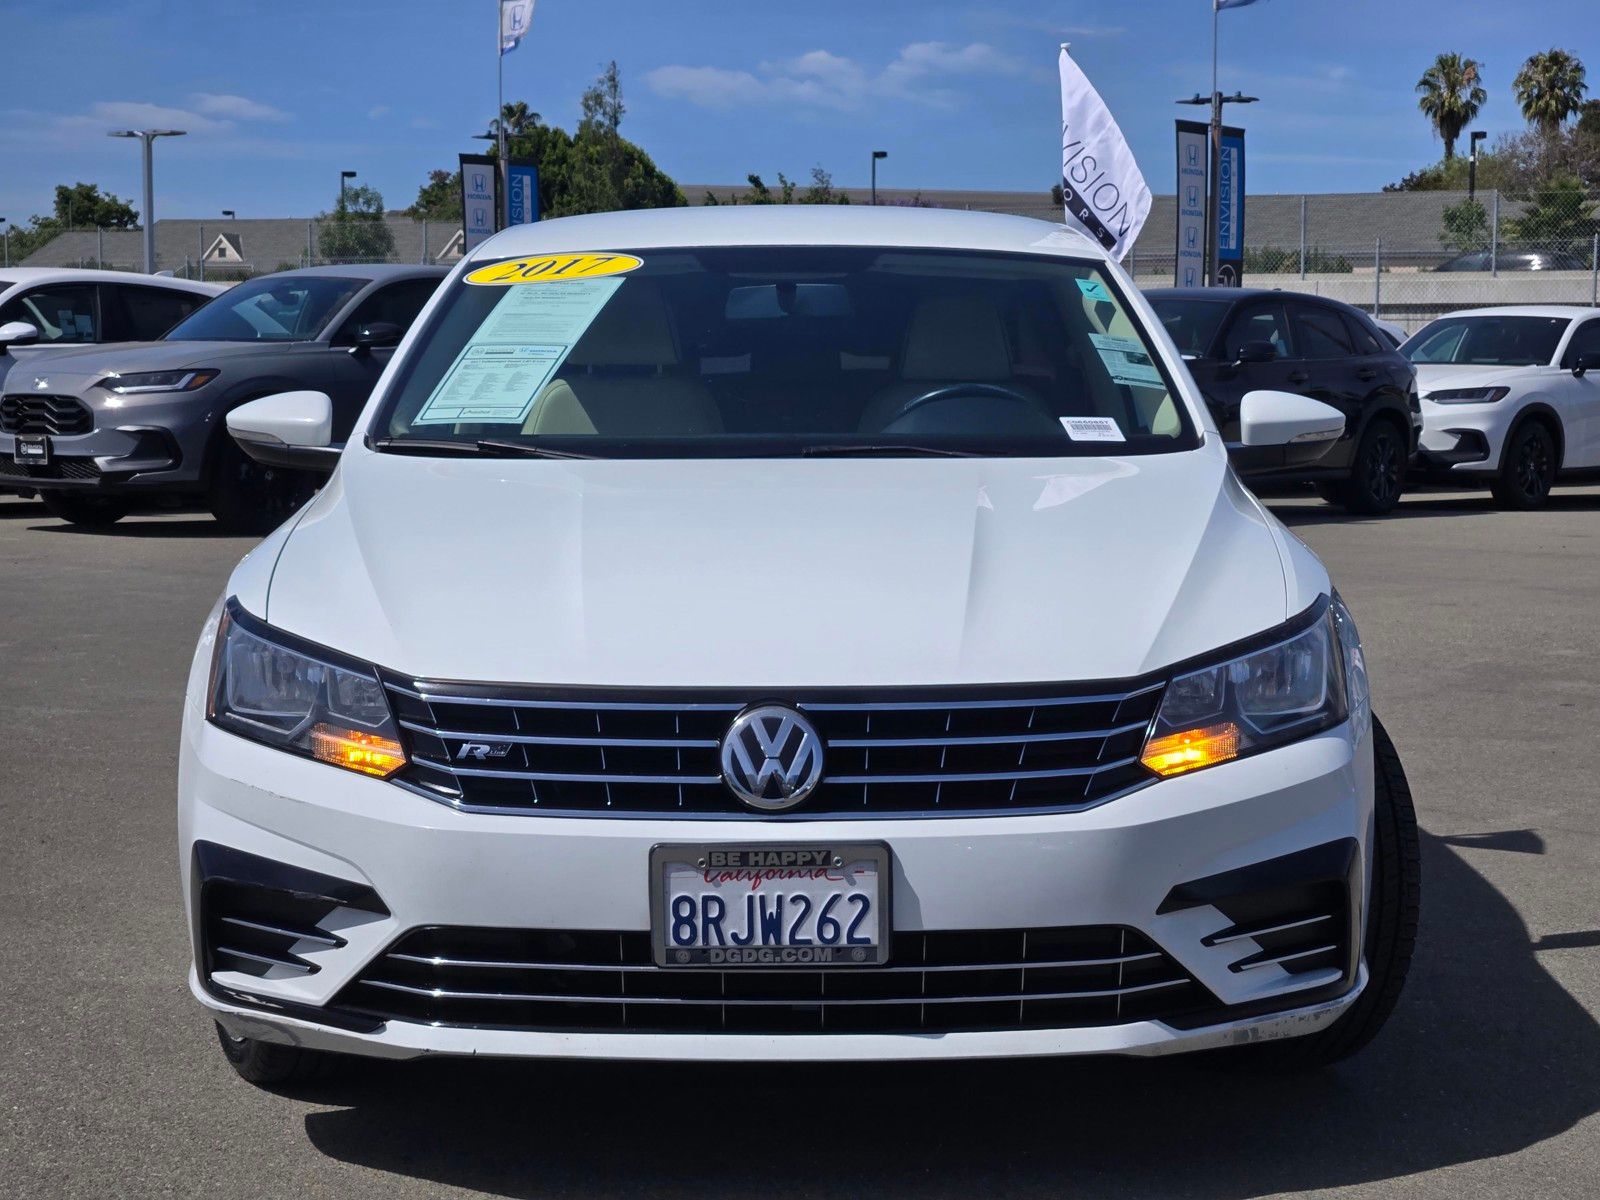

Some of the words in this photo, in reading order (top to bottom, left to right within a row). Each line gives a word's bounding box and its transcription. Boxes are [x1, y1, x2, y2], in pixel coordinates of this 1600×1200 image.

[1220, 146, 1230, 249] ENVISION
[489, 257, 617, 281] 2017
[456, 743, 490, 759] R
[711, 851, 742, 866] BE
[752, 851, 827, 866] HAPPY
[703, 867, 844, 891] California
[671, 893, 872, 946] 8RJW262
[710, 948, 833, 963] DGDG.COM
